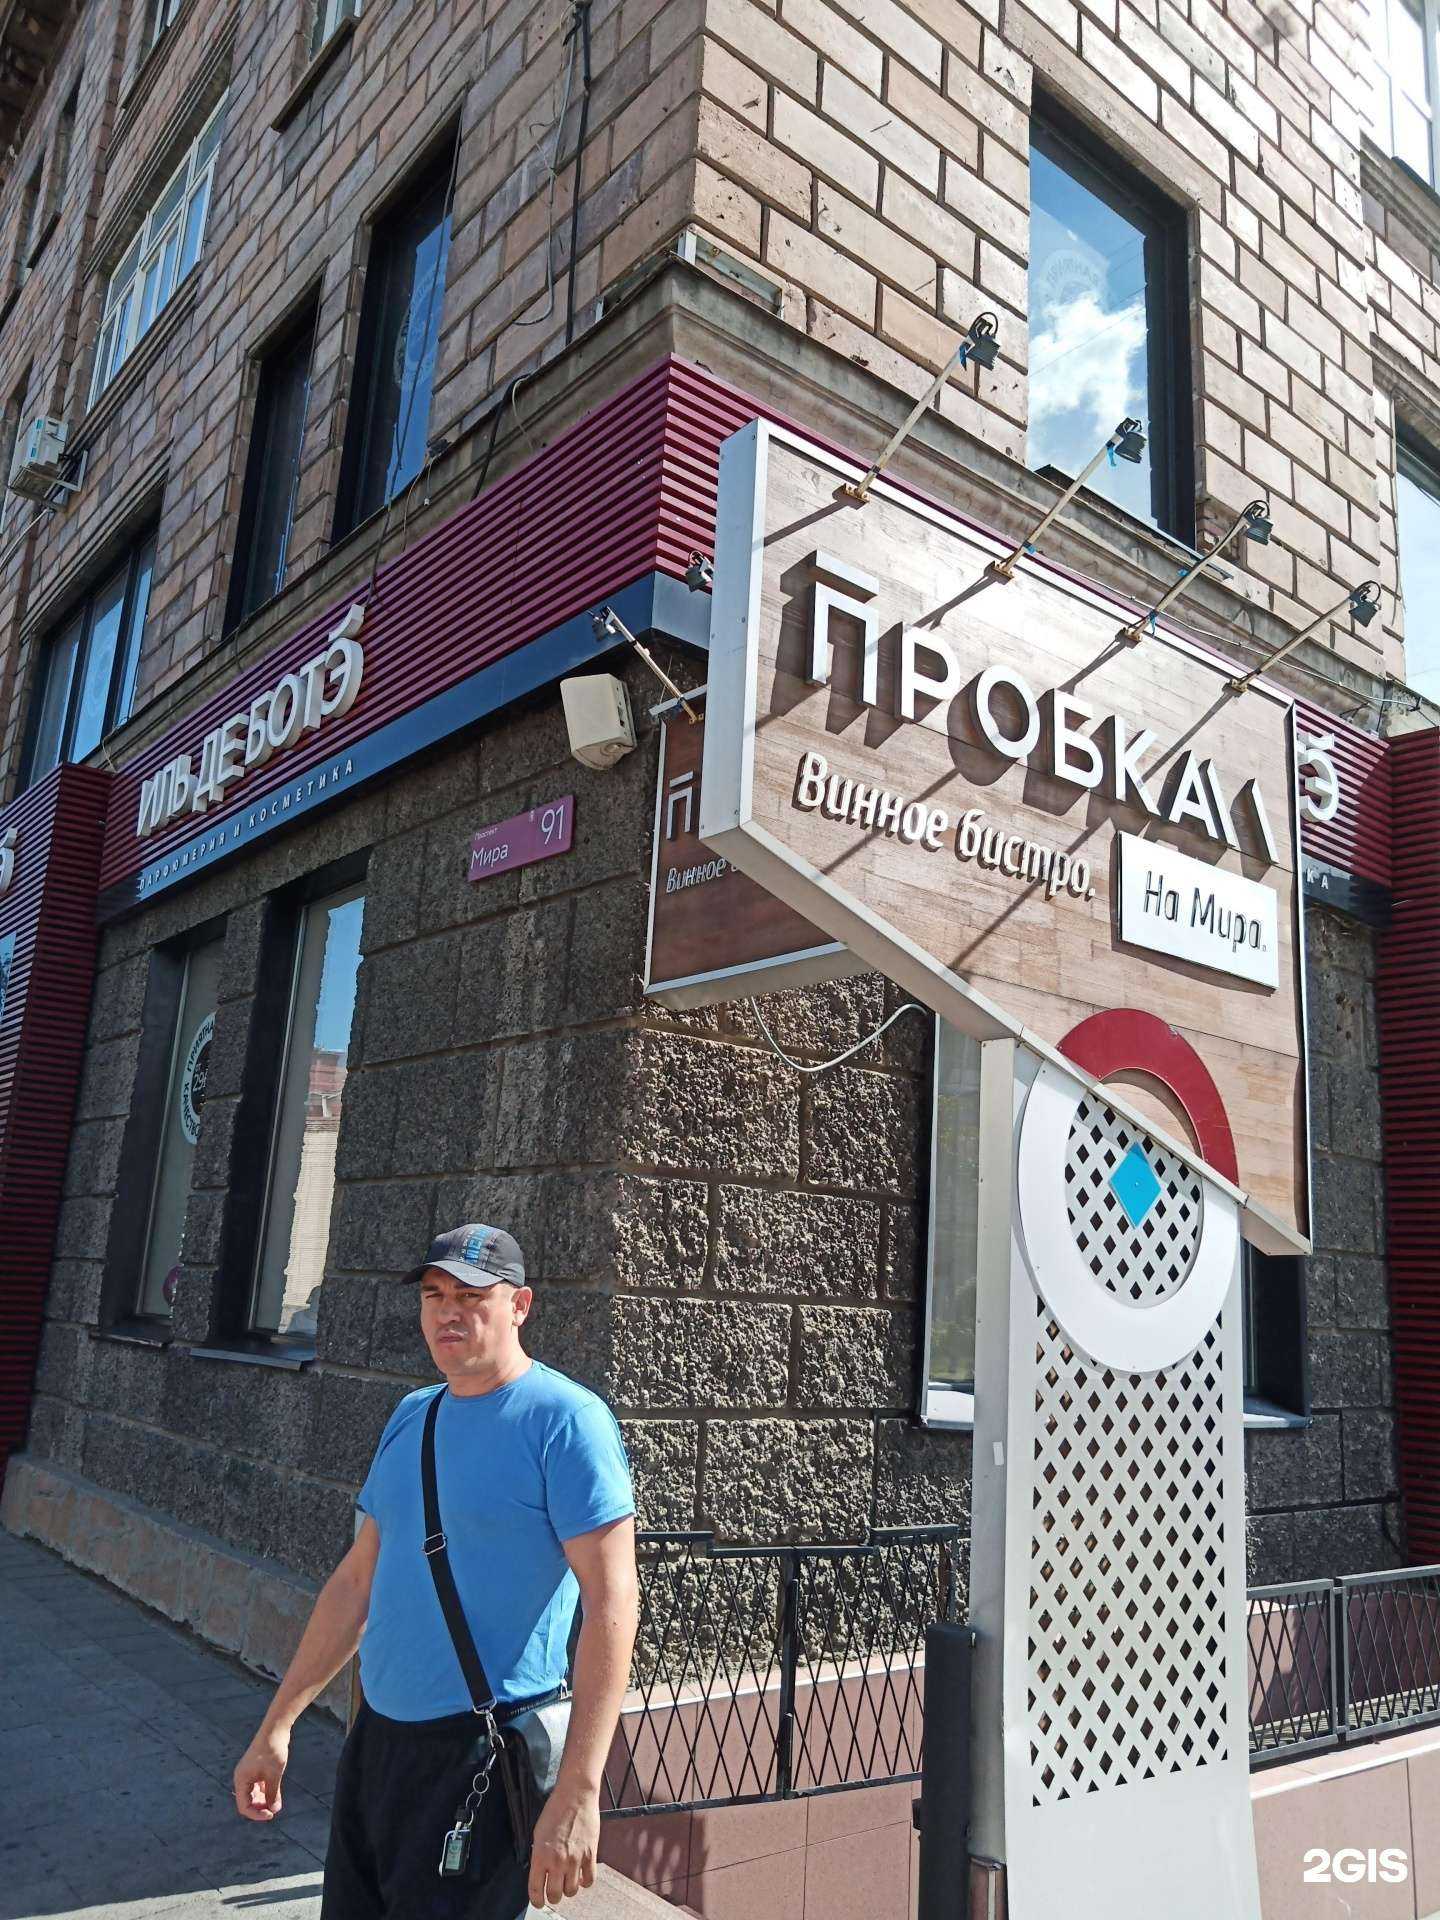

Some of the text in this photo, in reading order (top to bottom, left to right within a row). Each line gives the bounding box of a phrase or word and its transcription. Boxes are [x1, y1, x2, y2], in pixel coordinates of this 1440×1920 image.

[138, 758, 353, 892] ПАРФЮМЕРИЯ И КОСМЕТИКА
[541, 804, 565, 845] 91
[795, 751, 949, 850] Винное
[957, 807, 1096, 897] бистро.
[470, 844, 509, 870] Мира
[666, 857, 727, 894] Винное
[1143, 870, 1268, 954] На Мира.
